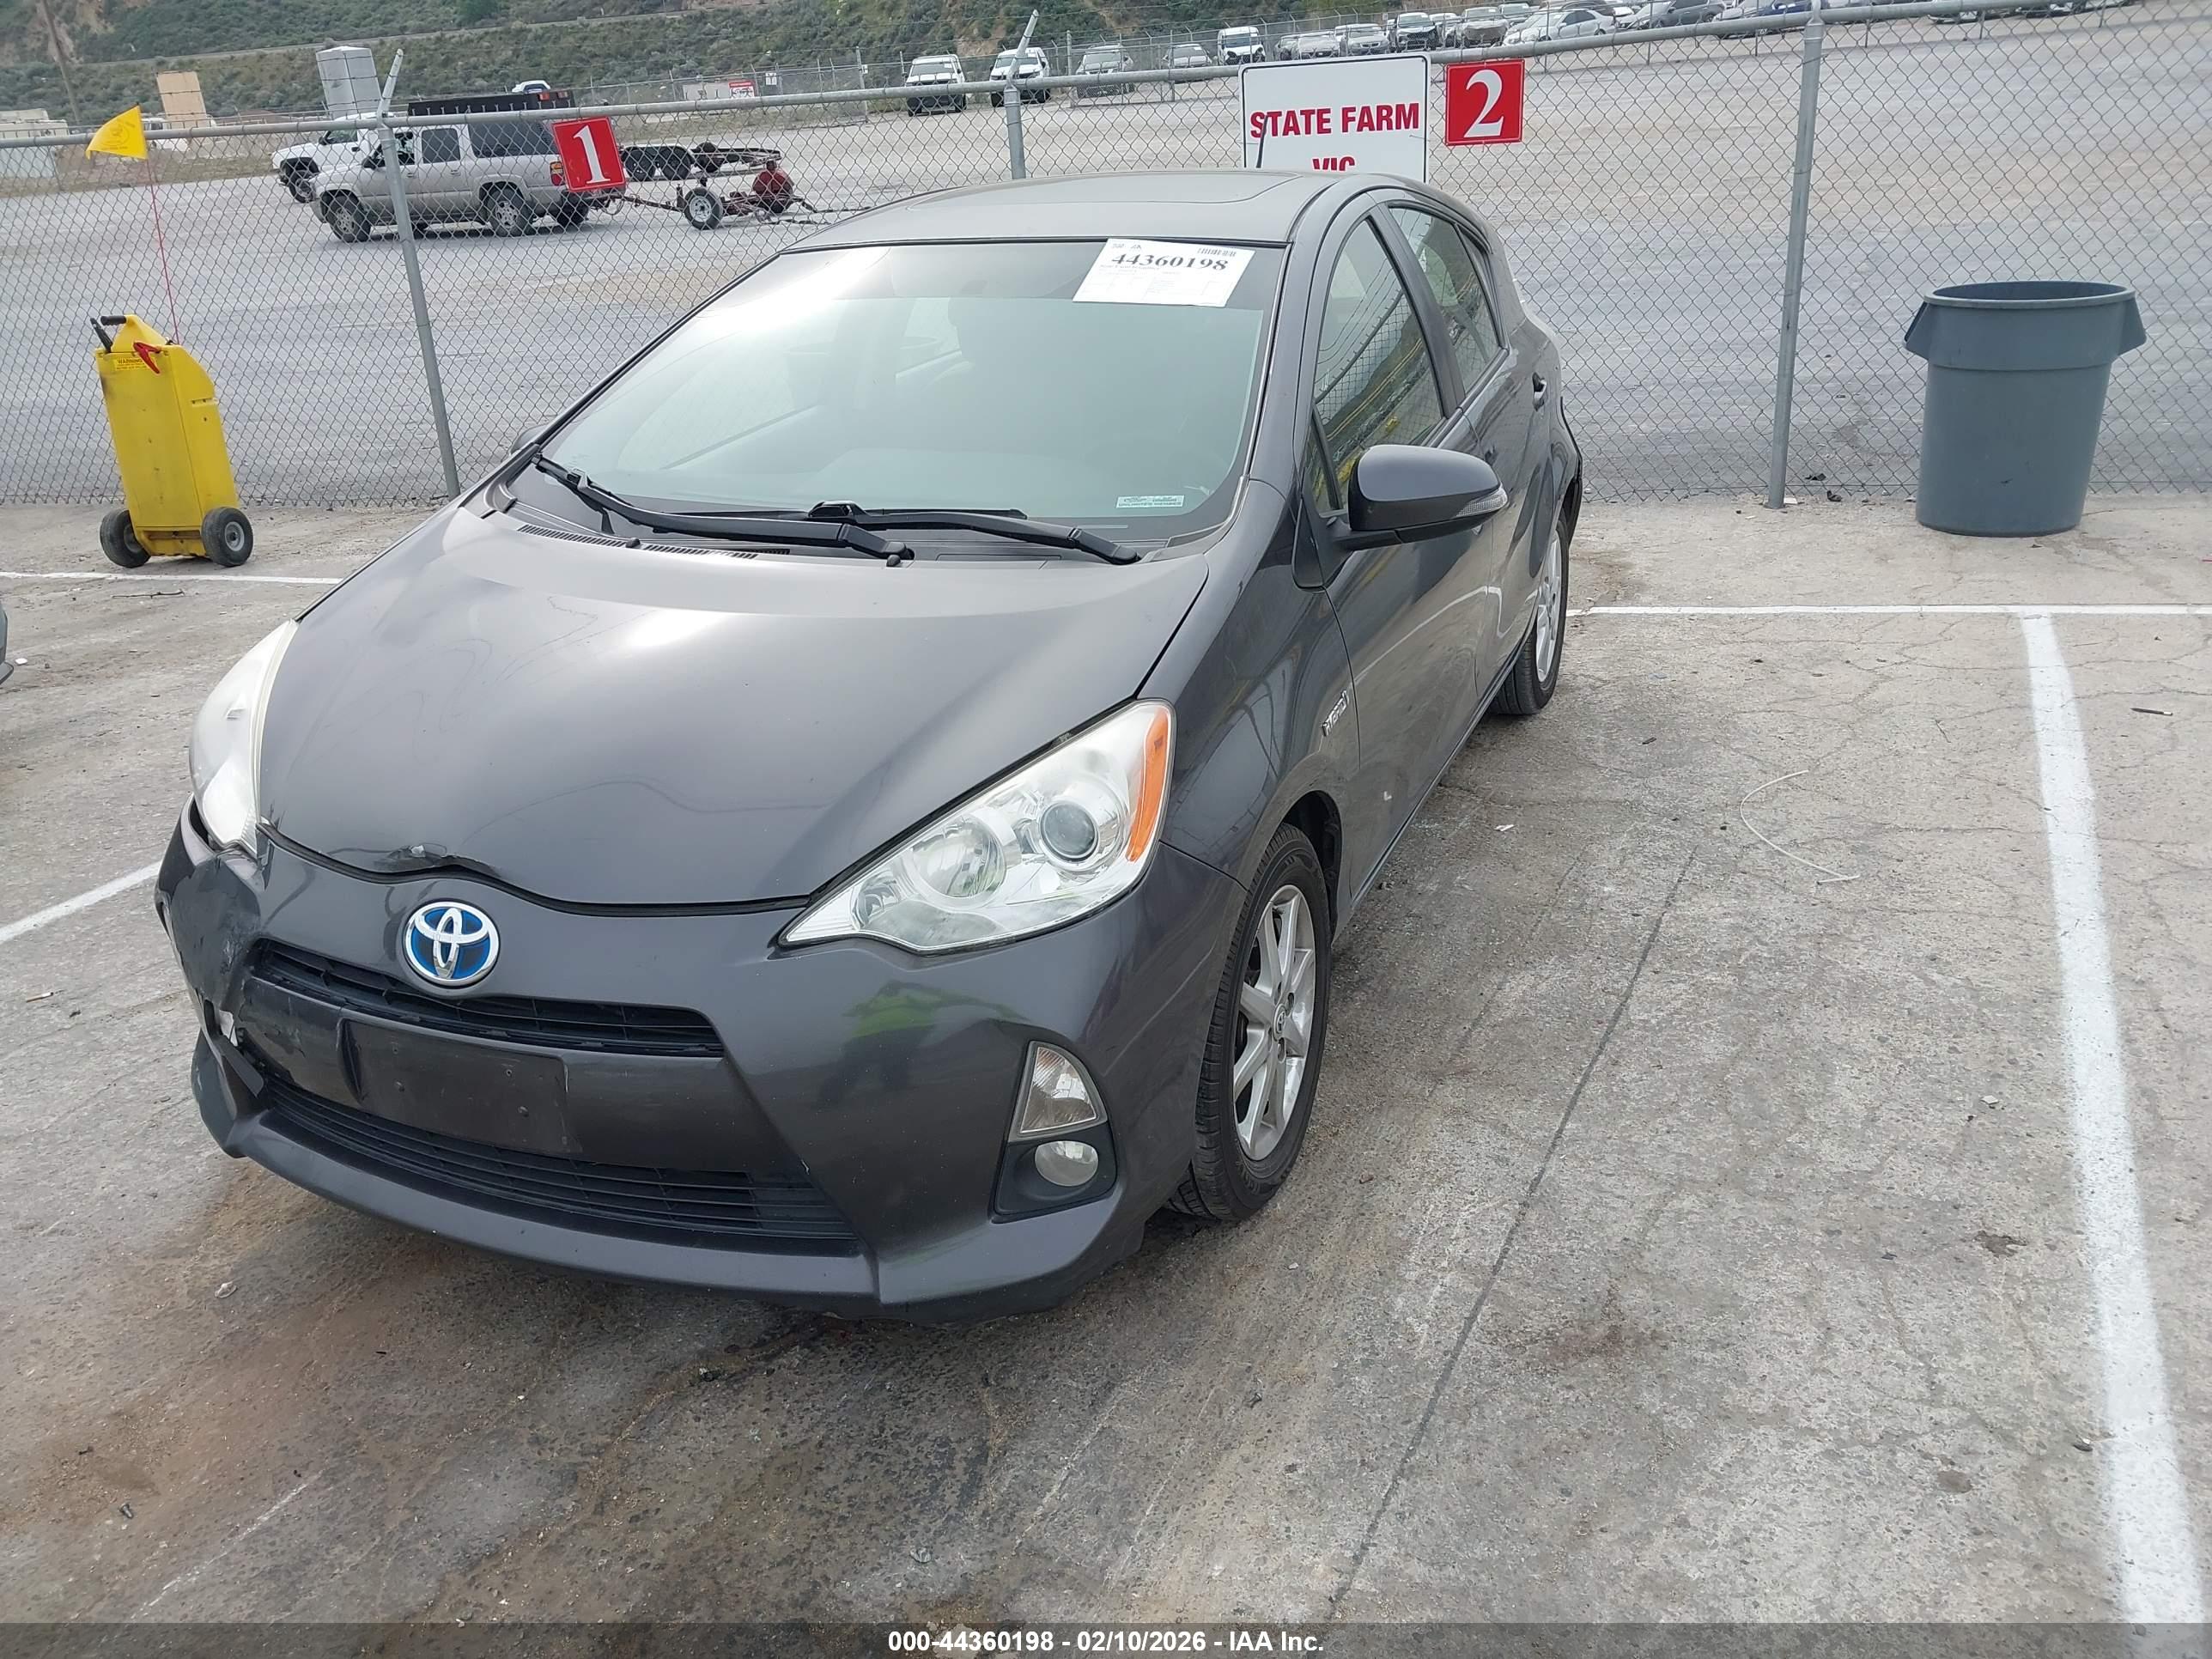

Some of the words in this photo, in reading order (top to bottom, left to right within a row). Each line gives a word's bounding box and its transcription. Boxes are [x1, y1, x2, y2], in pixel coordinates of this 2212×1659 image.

[1249, 108, 1331, 138] STATE
[1341, 102, 1419, 132] FARM
[1464, 69, 1504, 138] 2
[573, 125, 611, 185] 1
[1111, 252, 1229, 271] 44360198
